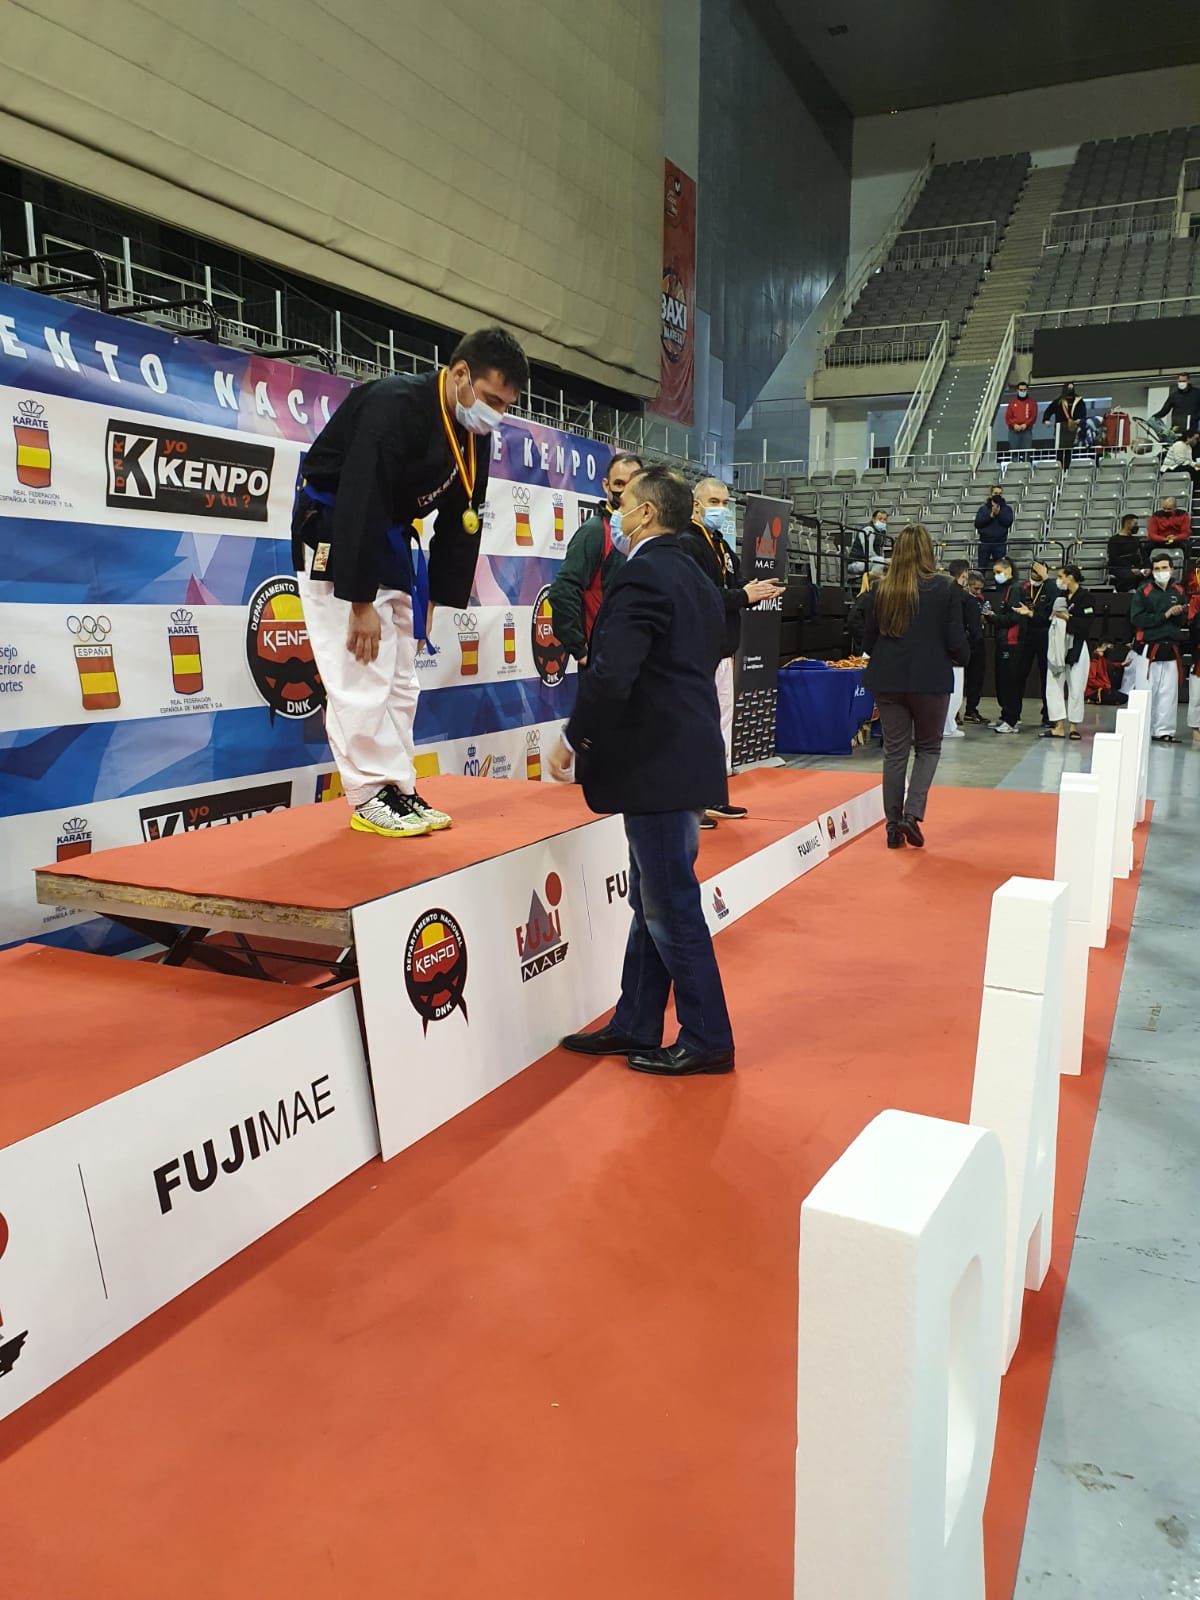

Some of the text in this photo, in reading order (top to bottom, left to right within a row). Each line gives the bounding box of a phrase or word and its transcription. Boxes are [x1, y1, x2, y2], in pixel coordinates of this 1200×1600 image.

[12, 416, 49, 429] KARATE
[163, 438, 188, 455] yo
[524, 437, 596, 481] KENPO
[157, 456, 269, 497] KENPO
[205, 493, 215, 508] y
[221, 493, 238, 508] tu
[754, 560, 775, 570] MAE
[251, 583, 295, 631] DEPARTAMENTO
[168, 626, 199, 634] KARATE
[77, 647, 109, 657] ESPAÑA
[24, 660, 36, 675] de
[286, 699, 311, 713] DNK
[188, 805, 210, 823] yo
[56, 831, 93, 844] KARATE
[515, 908, 562, 958] FUJI
[406, 913, 463, 971] DEPARTAMENTO NACIONAL
[415, 943, 456, 974] KENPO
[523, 947, 563, 981] MAE
[435, 1001, 453, 1018] DNK
[153, 1073, 336, 1215] FUJIMAE
